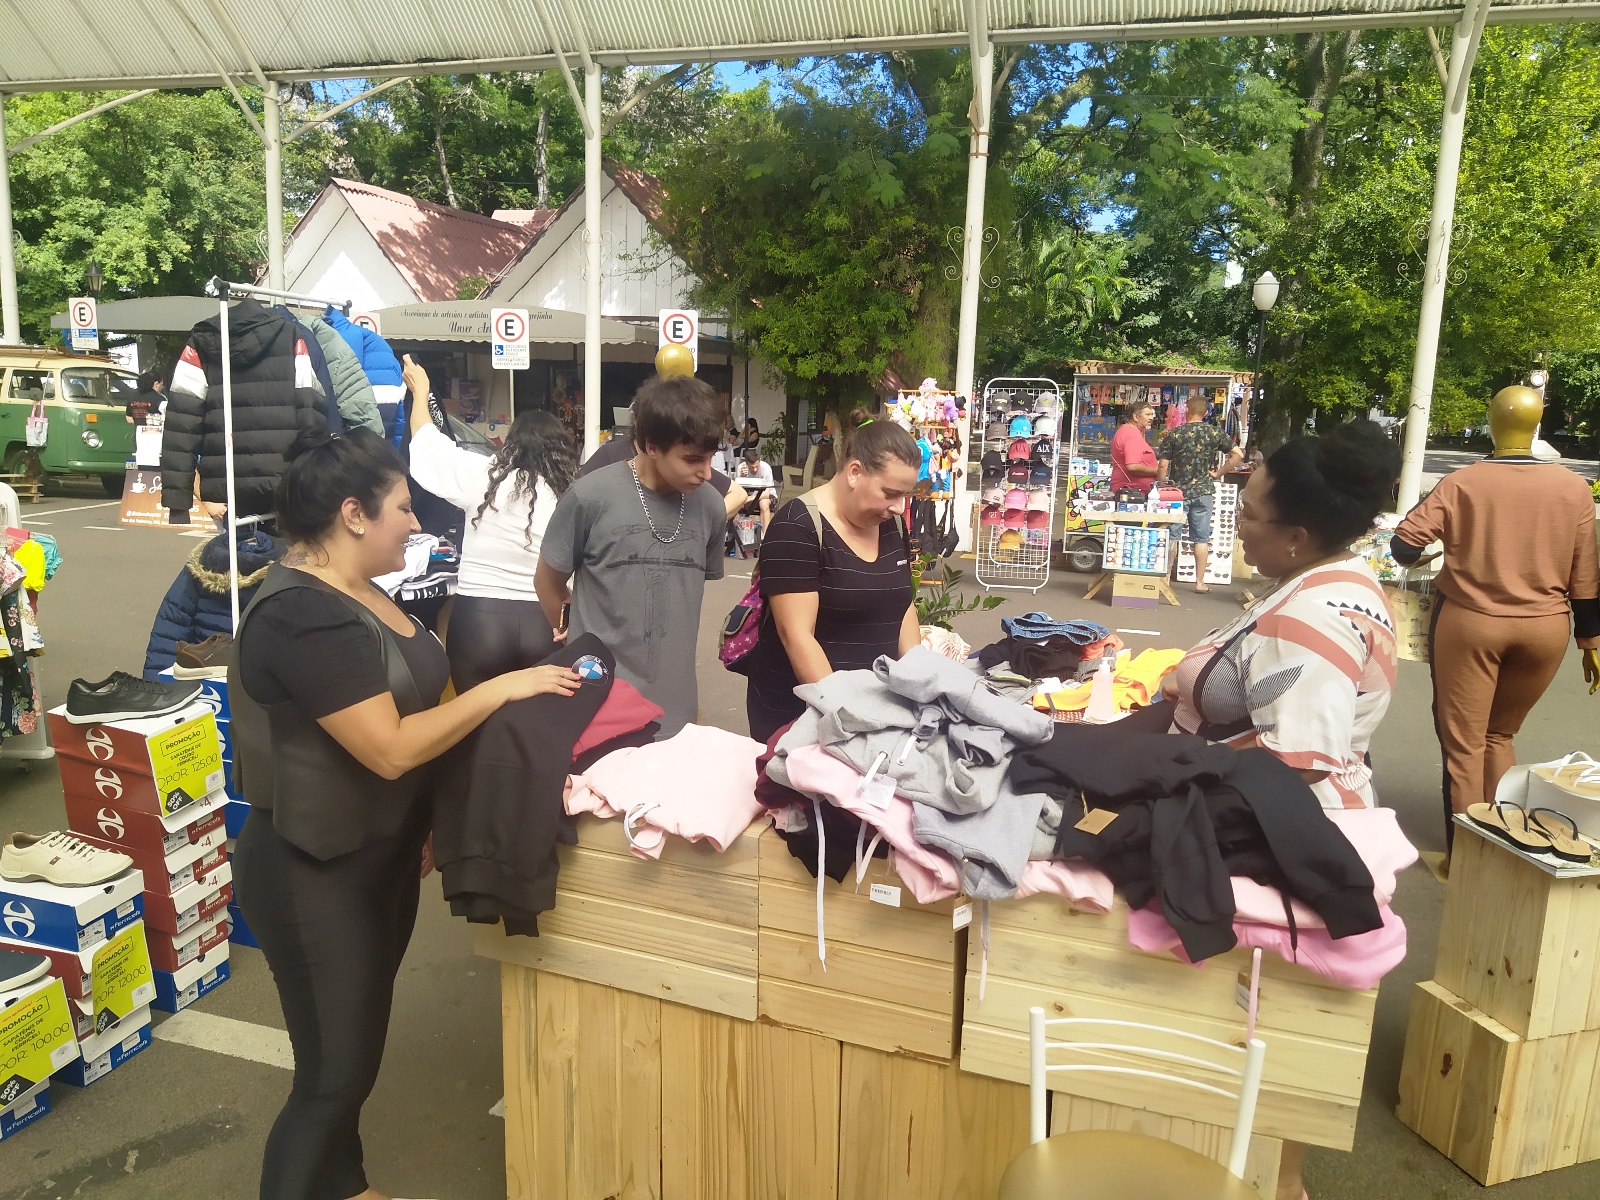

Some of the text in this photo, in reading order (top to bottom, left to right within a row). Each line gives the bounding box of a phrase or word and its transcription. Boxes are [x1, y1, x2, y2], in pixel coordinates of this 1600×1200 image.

[79, 306, 86, 321] E
[529, 311, 553, 321] grejinha
[505, 319, 515, 336] E
[673, 321, 683, 338] E
[166, 730, 200, 750] PROMOÇÃO
[192, 753, 218, 772] 125,00
[172, 796, 182, 810] OFF
[98, 943, 129, 969] PROMOÇÃO
[118, 965, 146, 989] 120,00
[3, 1017, 44, 1047] SAPATÊNIS DE
[14, 1029, 35, 1045] COURO
[31, 1022, 69, 1052] 100,00
[0, 1080, 16, 1100] 50%
[8, 1083, 20, 1101] OFF
